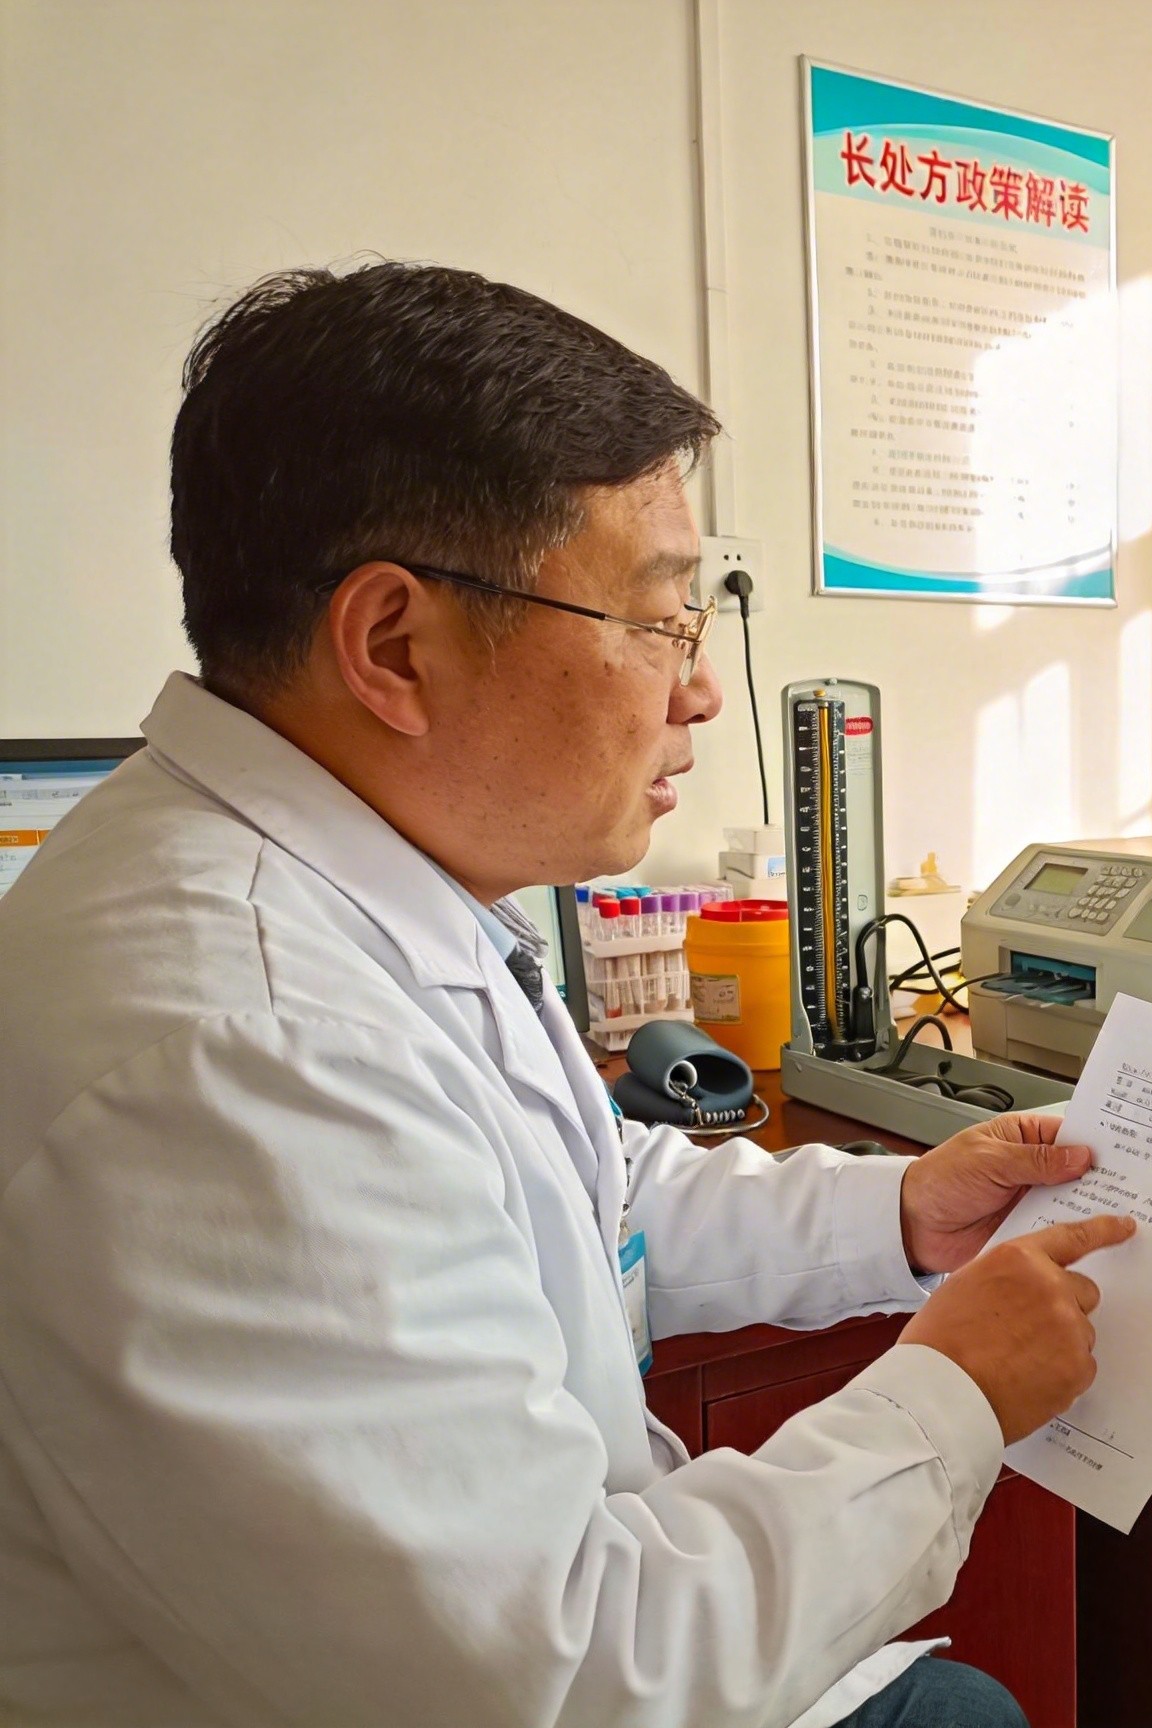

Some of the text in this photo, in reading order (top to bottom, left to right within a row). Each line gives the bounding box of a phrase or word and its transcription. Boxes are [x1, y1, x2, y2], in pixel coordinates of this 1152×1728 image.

[840, 131, 1090, 233] 长处方政策解读
